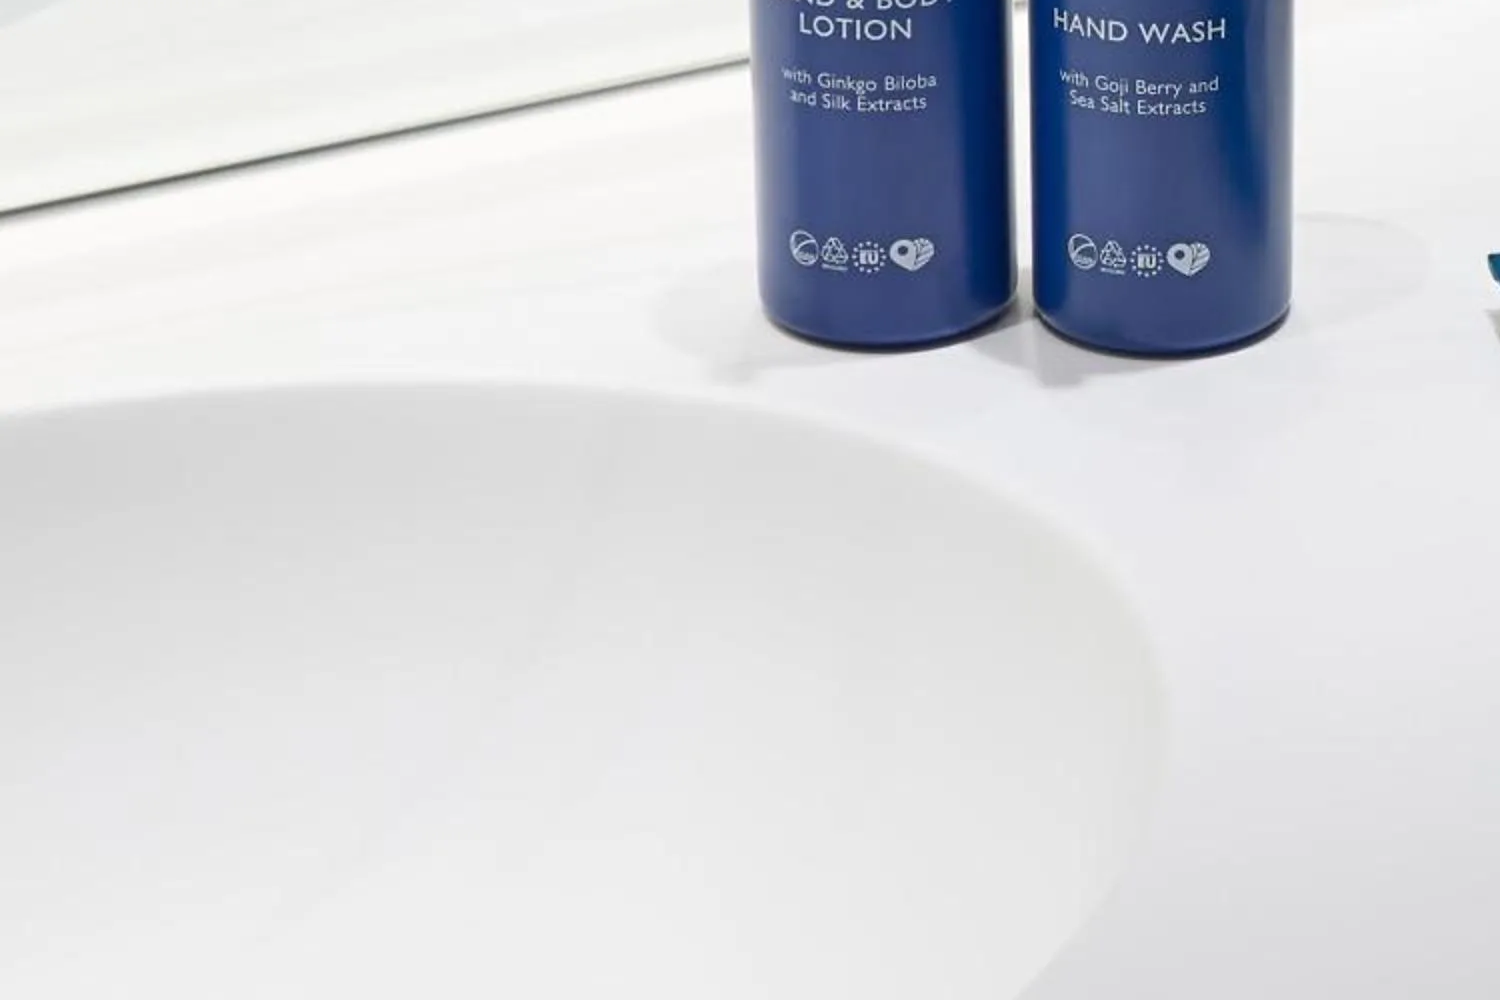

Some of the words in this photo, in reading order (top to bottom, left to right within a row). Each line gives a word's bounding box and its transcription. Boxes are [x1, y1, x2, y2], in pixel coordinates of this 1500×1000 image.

[799, 12, 912, 41] LOTION
[1053, 7, 1128, 42] HAND
[1137, 18, 1226, 44] WASH
[781, 67, 812, 85] with
[817, 72, 878, 96] Ginkgo
[884, 74, 937, 92] Biloba
[1059, 68, 1089, 88] with
[1095, 75, 1129, 96] Goji
[1135, 79, 1183, 99] Berry
[1189, 76, 1220, 93] and
[790, 89, 817, 106] and
[822, 93, 850, 110] Silk
[857, 96, 928, 112] Extracts
[1069, 89, 1095, 109] Sea
[1101, 95, 1131, 115] Salt
[1137, 99, 1207, 115] Extracts
